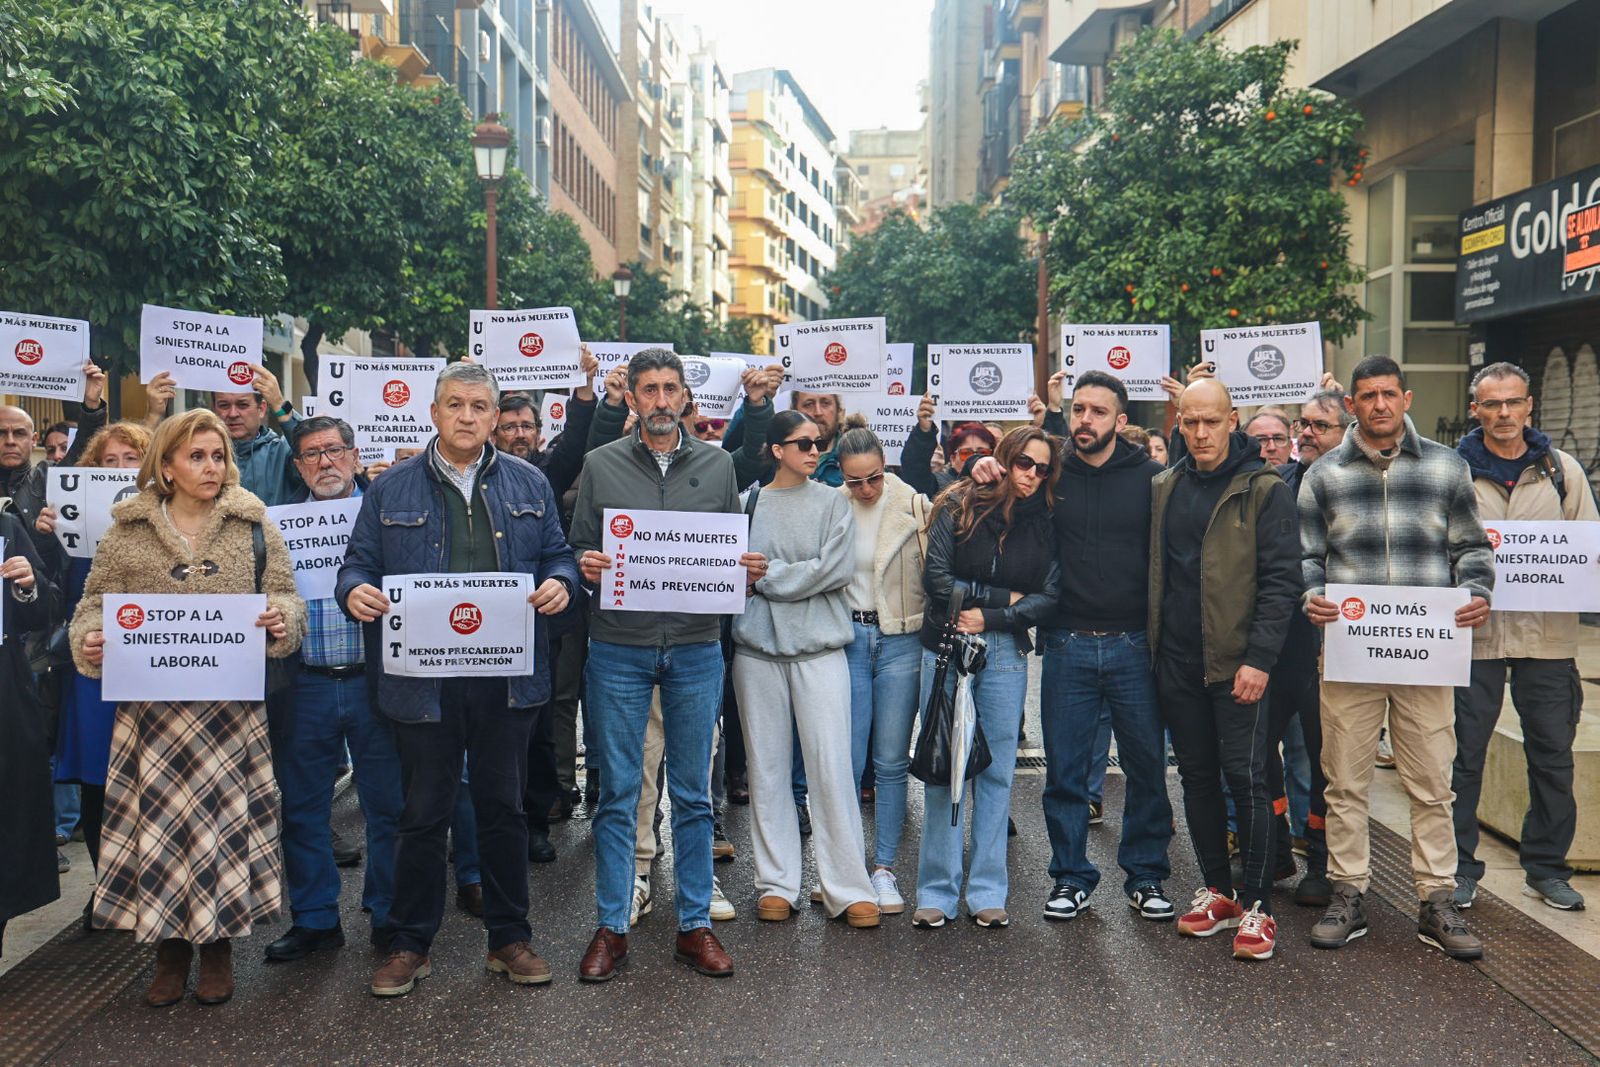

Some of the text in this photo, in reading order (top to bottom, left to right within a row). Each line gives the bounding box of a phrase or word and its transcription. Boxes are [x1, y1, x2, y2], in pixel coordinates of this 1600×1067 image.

[1510, 182, 1579, 259] Gold
[507, 314, 526, 322] MÁS
[528, 312, 569, 321] MUERTES
[5, 317, 77, 332] MÁS MUERTES
[172, 320, 229, 336] STOP A LA
[811, 324, 830, 333] MÁS
[832, 323, 873, 332] MUERTES
[1097, 328, 1115, 336] MÁS
[1239, 330, 1259, 339] MÁS
[1261, 328, 1306, 337] MUERTES
[155, 335, 247, 354] SINIESTRALIDAD
[522, 336, 541, 346] UGT
[19, 342, 40, 354] UGT
[963, 346, 981, 355] MÁS
[175, 355, 226, 369] LABORAL
[595, 353, 620, 362] STOP
[371, 362, 389, 371] MÁS
[519, 364, 578, 373] PRECARIEDAD
[12, 373, 77, 384] PRECARIEDAD
[517, 373, 570, 381] PREVENCIÓN
[824, 373, 879, 381] PRECARIEDAD
[8, 381, 67, 391] PREVENCIÓN
[1253, 382, 1315, 391] PRECARIEDAD
[693, 393, 732, 401] CARIEDAD
[1251, 390, 1306, 400] PREVENCIÓN
[697, 402, 724, 410] ENCIÓN
[876, 407, 914, 417] NO MÁS
[374, 414, 389, 422] NO
[357, 425, 432, 433] PRECARIEDAD
[868, 424, 904, 433] UERTES
[108, 473, 129, 482] MÁS
[60, 474, 80, 548] UGT
[280, 513, 348, 530] STOP A LA
[634, 529, 737, 544] NO MÁS MUERTES
[1503, 534, 1536, 544] STOP
[1540, 534, 1549, 544] A
[1553, 534, 1568, 544] LA
[286, 534, 350, 551] ESTRALID
[629, 554, 736, 567] MENOS PRECARIEDAD
[1496, 554, 1588, 564] NIESTRALIDAD
[613, 544, 625, 606] INFORMA
[1506, 573, 1565, 584] LABORAL
[434, 578, 460, 588] MÁS
[463, 579, 518, 588] MUERTES
[630, 578, 735, 593] MÁS PREVENCIÓN
[454, 607, 479, 620] UGT
[1370, 602, 1427, 616] NO MÁS
[147, 609, 223, 621] STOP A LA
[389, 588, 402, 658] UGT
[1348, 625, 1454, 640] MUERTES EN EL
[123, 632, 245, 644] SINIESTRALIDAD
[409, 646, 523, 655] MENOS PRECARIEDAD
[1367, 647, 1429, 660] TRABAJO
[151, 656, 219, 667] LABORAL
[420, 657, 512, 666] MÁS PREVENCIÓN
